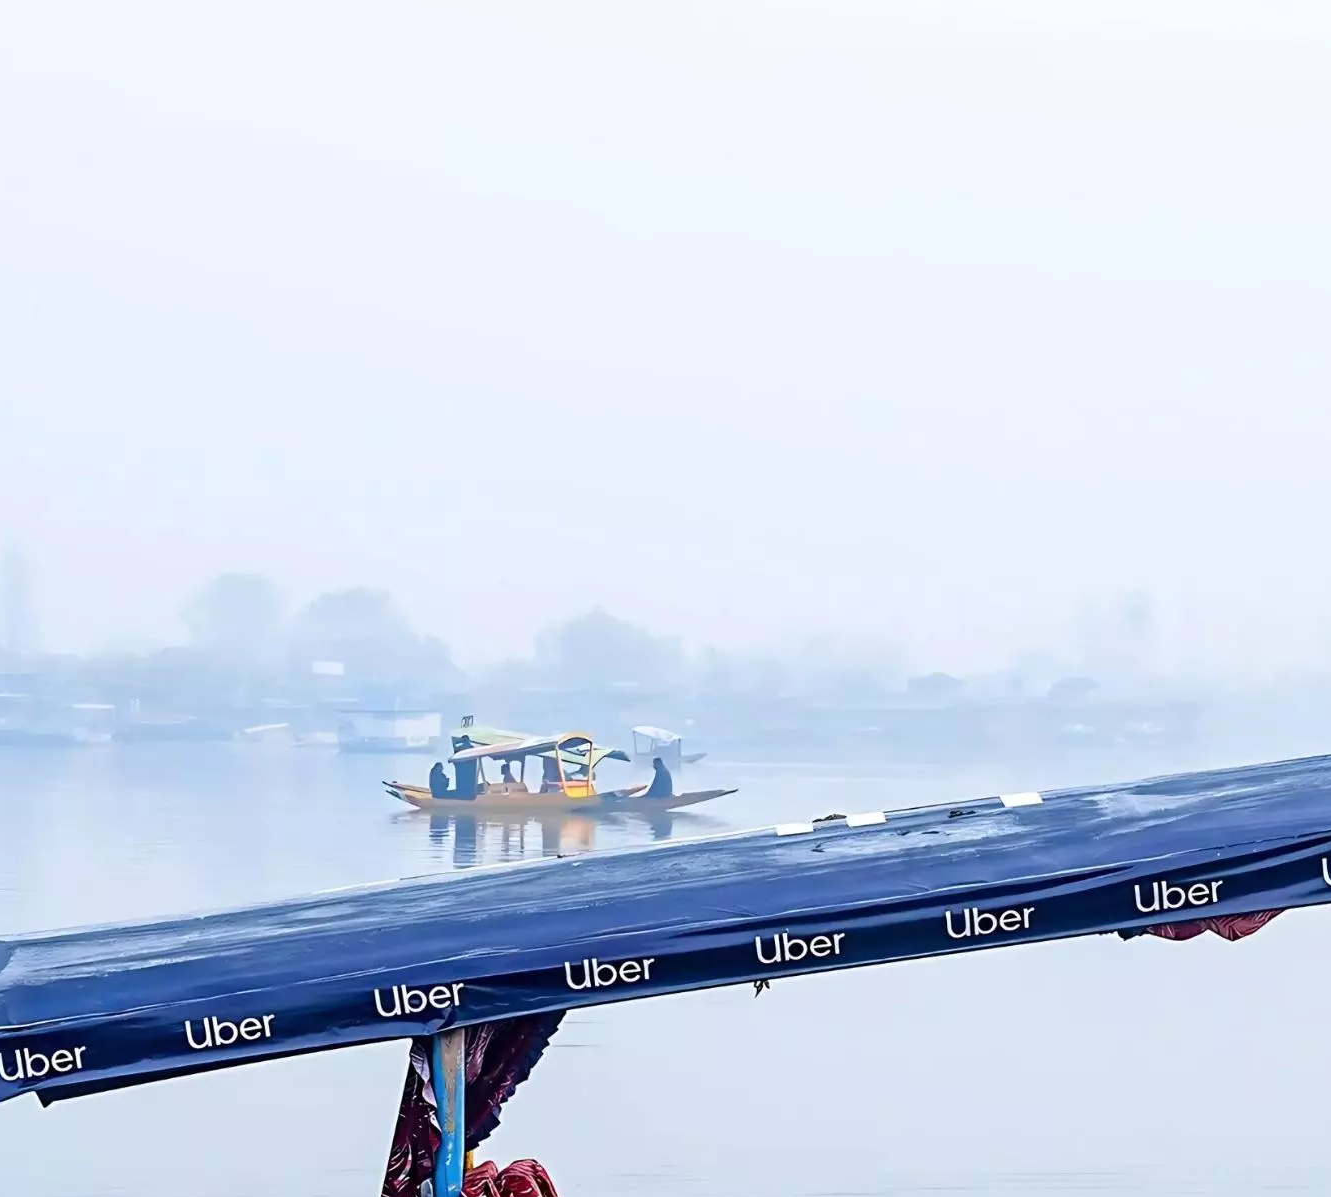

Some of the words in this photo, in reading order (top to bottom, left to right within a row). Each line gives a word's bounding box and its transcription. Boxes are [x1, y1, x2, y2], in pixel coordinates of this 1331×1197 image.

[1134, 880, 1223, 913] Uber
[945, 907, 1035, 939] Uber
[755, 932, 845, 964] Uber
[564, 957, 655, 990] Uber
[374, 982, 464, 1017] Uber
[184, 1014, 275, 1049] Uber
